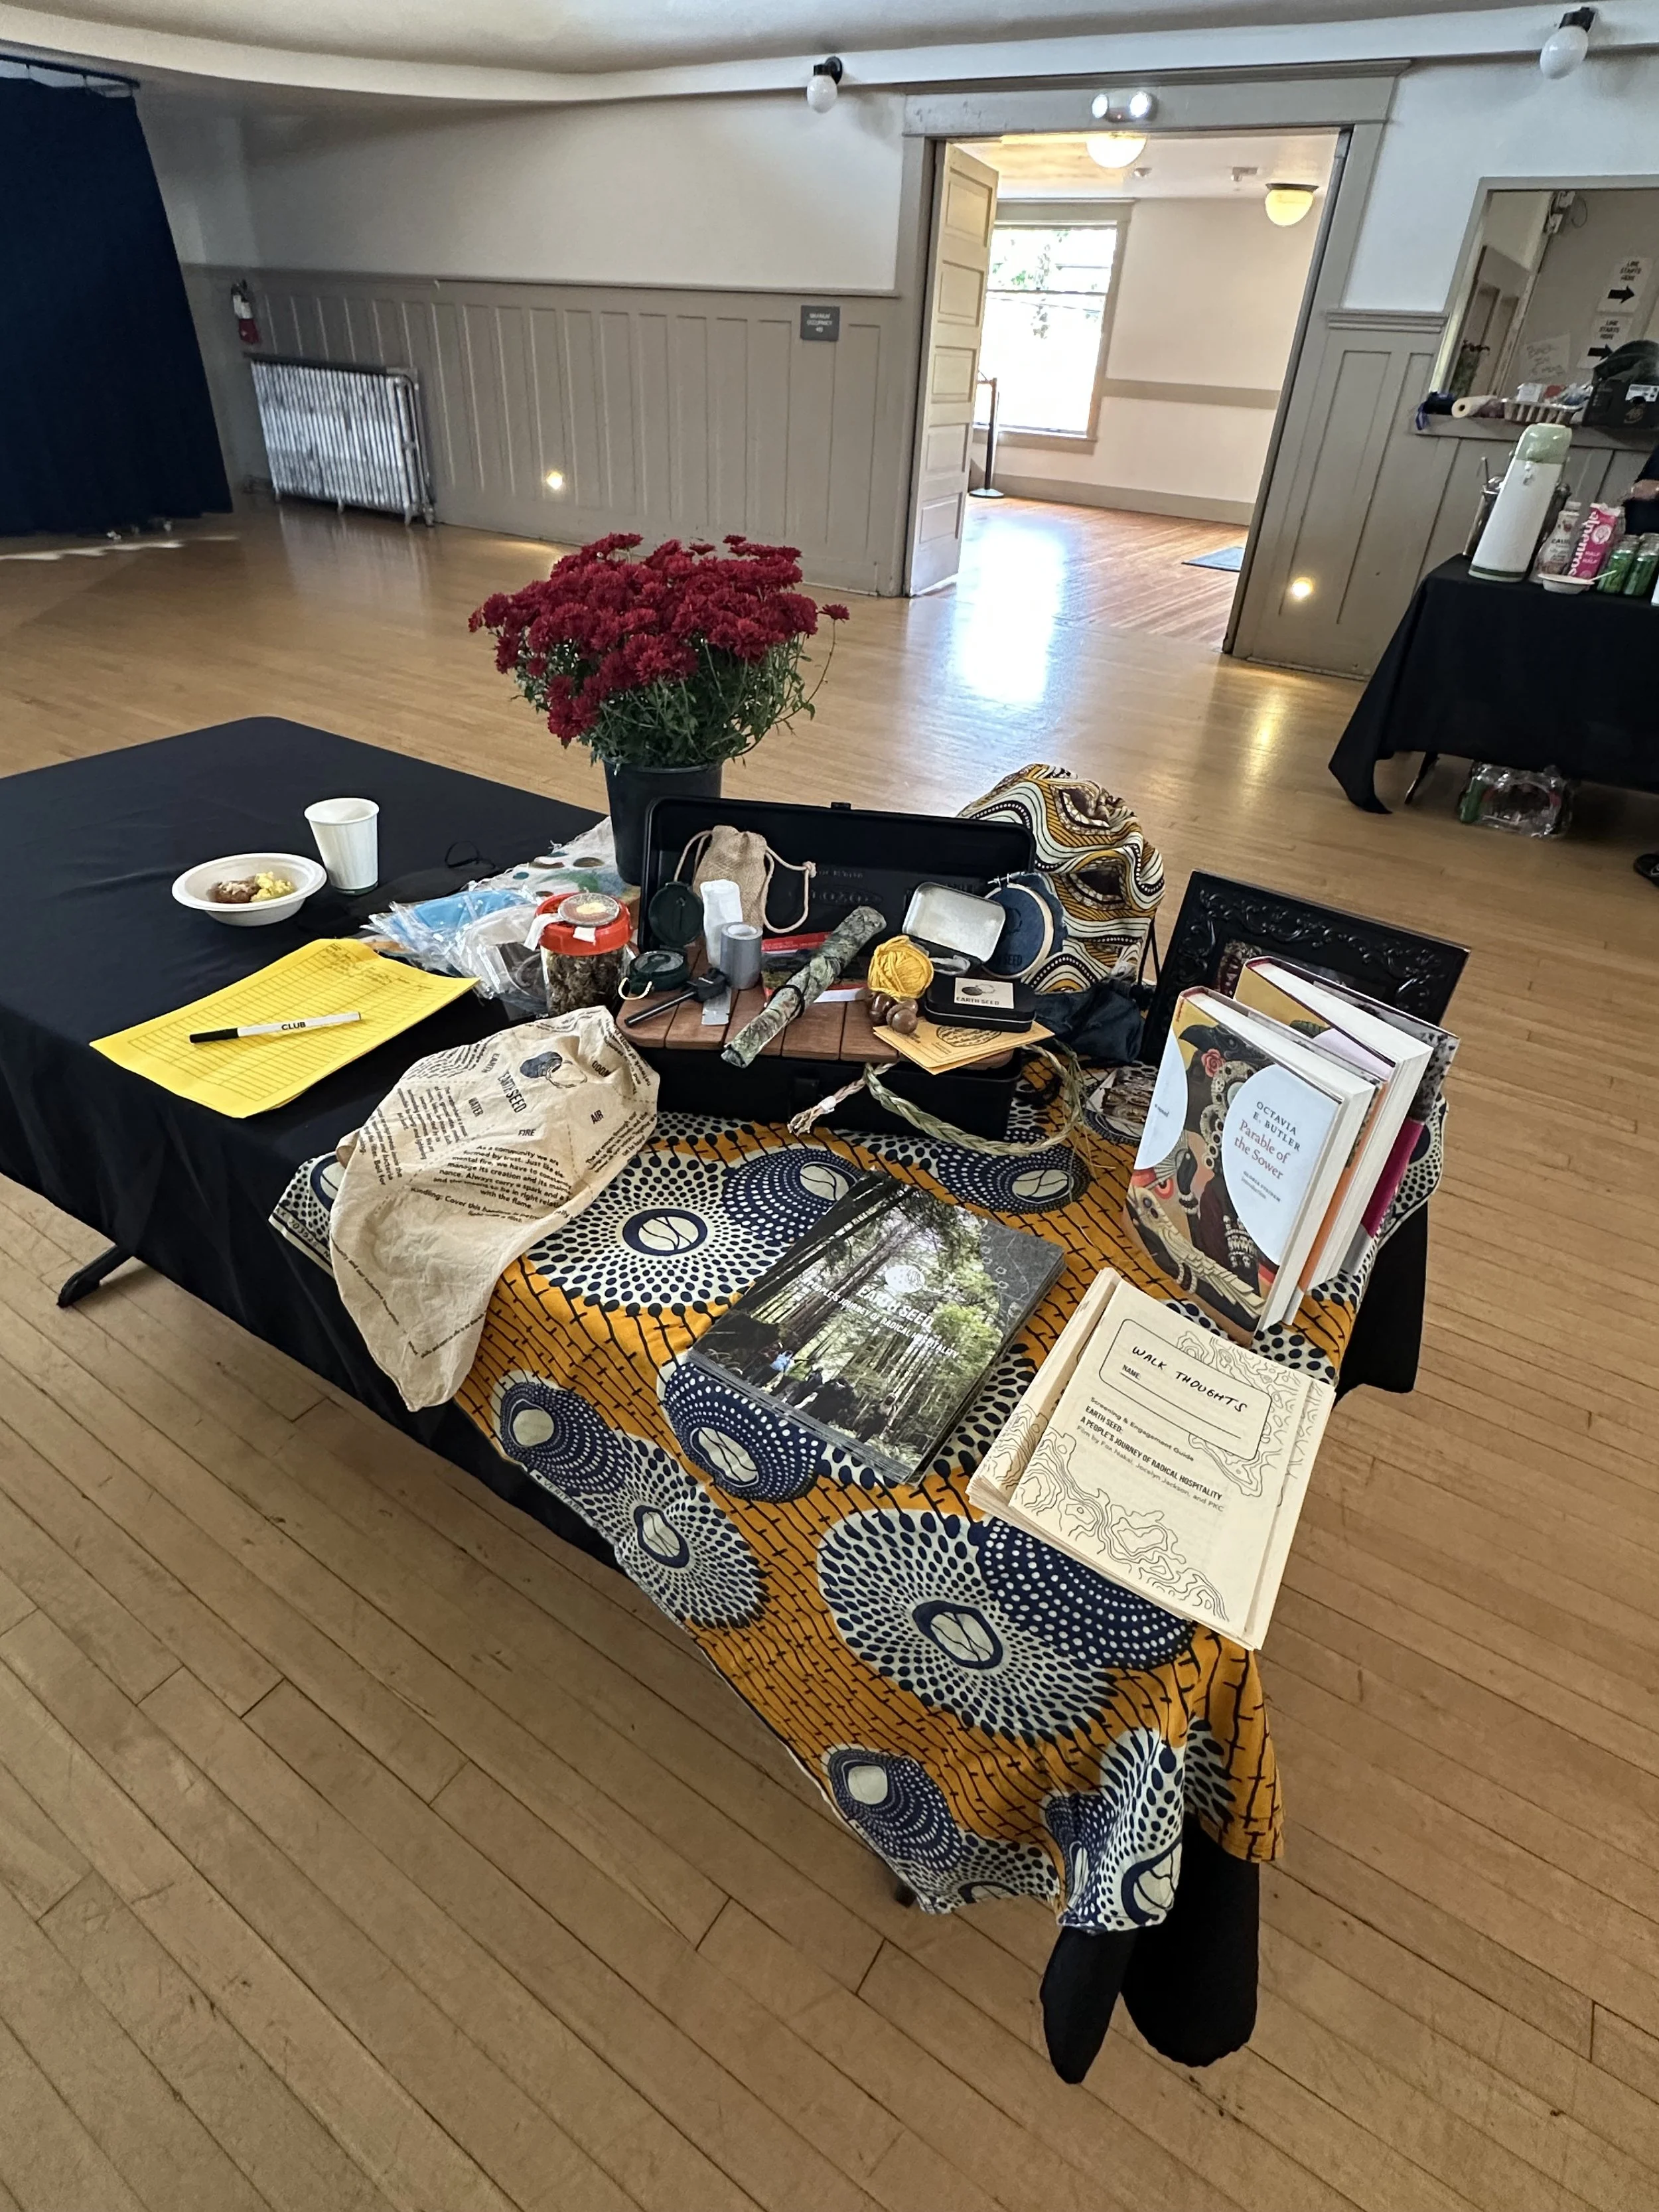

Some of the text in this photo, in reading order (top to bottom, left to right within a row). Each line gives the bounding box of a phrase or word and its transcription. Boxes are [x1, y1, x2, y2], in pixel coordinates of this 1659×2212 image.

[1567, 511, 1600, 575] alpenros
[619, 1036, 632, 1053] roots
[634, 1061, 651, 1086] network
[469, 1097, 484, 1117] WATER
[506, 1088, 527, 1114] SEED
[591, 1110, 604, 1124] AIR
[613, 1120, 630, 1137] through
[1256, 1101, 1297, 1136] OCTAVIA
[1239, 1120, 1291, 1163] Parable of
[1253, 1112, 1301, 1152] E. BUTLER
[494, 1147, 535, 1159] community
[1234, 1136, 1283, 1180] the Sower
[374, 1159, 383, 1174] Boil
[383, 1155, 394, 1180] bacteria
[447, 1163, 477, 1171] manage
[490, 1169, 521, 1180] creation
[510, 1163, 527, 1172] have
[543, 1163, 553, 1172] like
[466, 1173, 492, 1183] Always
[523, 1185, 541, 1194] spark
[411, 1187, 443, 1201] Kindling:
[445, 1195, 467, 1207] Cover
[498, 1193, 510, 1202] the
[512, 1197, 532, 1210] flame.
[520, 1192, 538, 1203] right
[856, 1285, 934, 1328] EARTH SEED
[839, 1297, 871, 1317] JOURNEY
[870, 1312, 881, 1321] OF
[879, 1317, 911, 1337] RADICAL
[911, 1331, 959, 1359] HOSPITALITY
[1122, 1364, 1141, 1380] NAME:
[1132, 1346, 1248, 1412] WALK THOUGHTS
[1085, 1406, 1123, 1434] EARTH SEED:
[1090, 1396, 1121, 1421] Screening
[1129, 1422, 1172, 1450] Engagement
[1173, 1447, 1194, 1461] Guide
[1076, 1424, 1090, 1438] Film
[1091, 1435, 1100, 1445] by
[1135, 1462, 1161, 1481] Jocelyn
[1161, 1478, 1190, 1498] Jackson,
[1192, 1495, 1208, 1505] and
[1208, 1501, 1225, 1512] PKC
[1086, 1421, 1115, 1441] PEOPLE'S
[1114, 1438, 1143, 1459] JOURNEY
[1142, 1454, 1151, 1463] OF
[1151, 1459, 1179, 1481] RADICAL
[1179, 1475, 1222, 1501] HOSPITALITY
